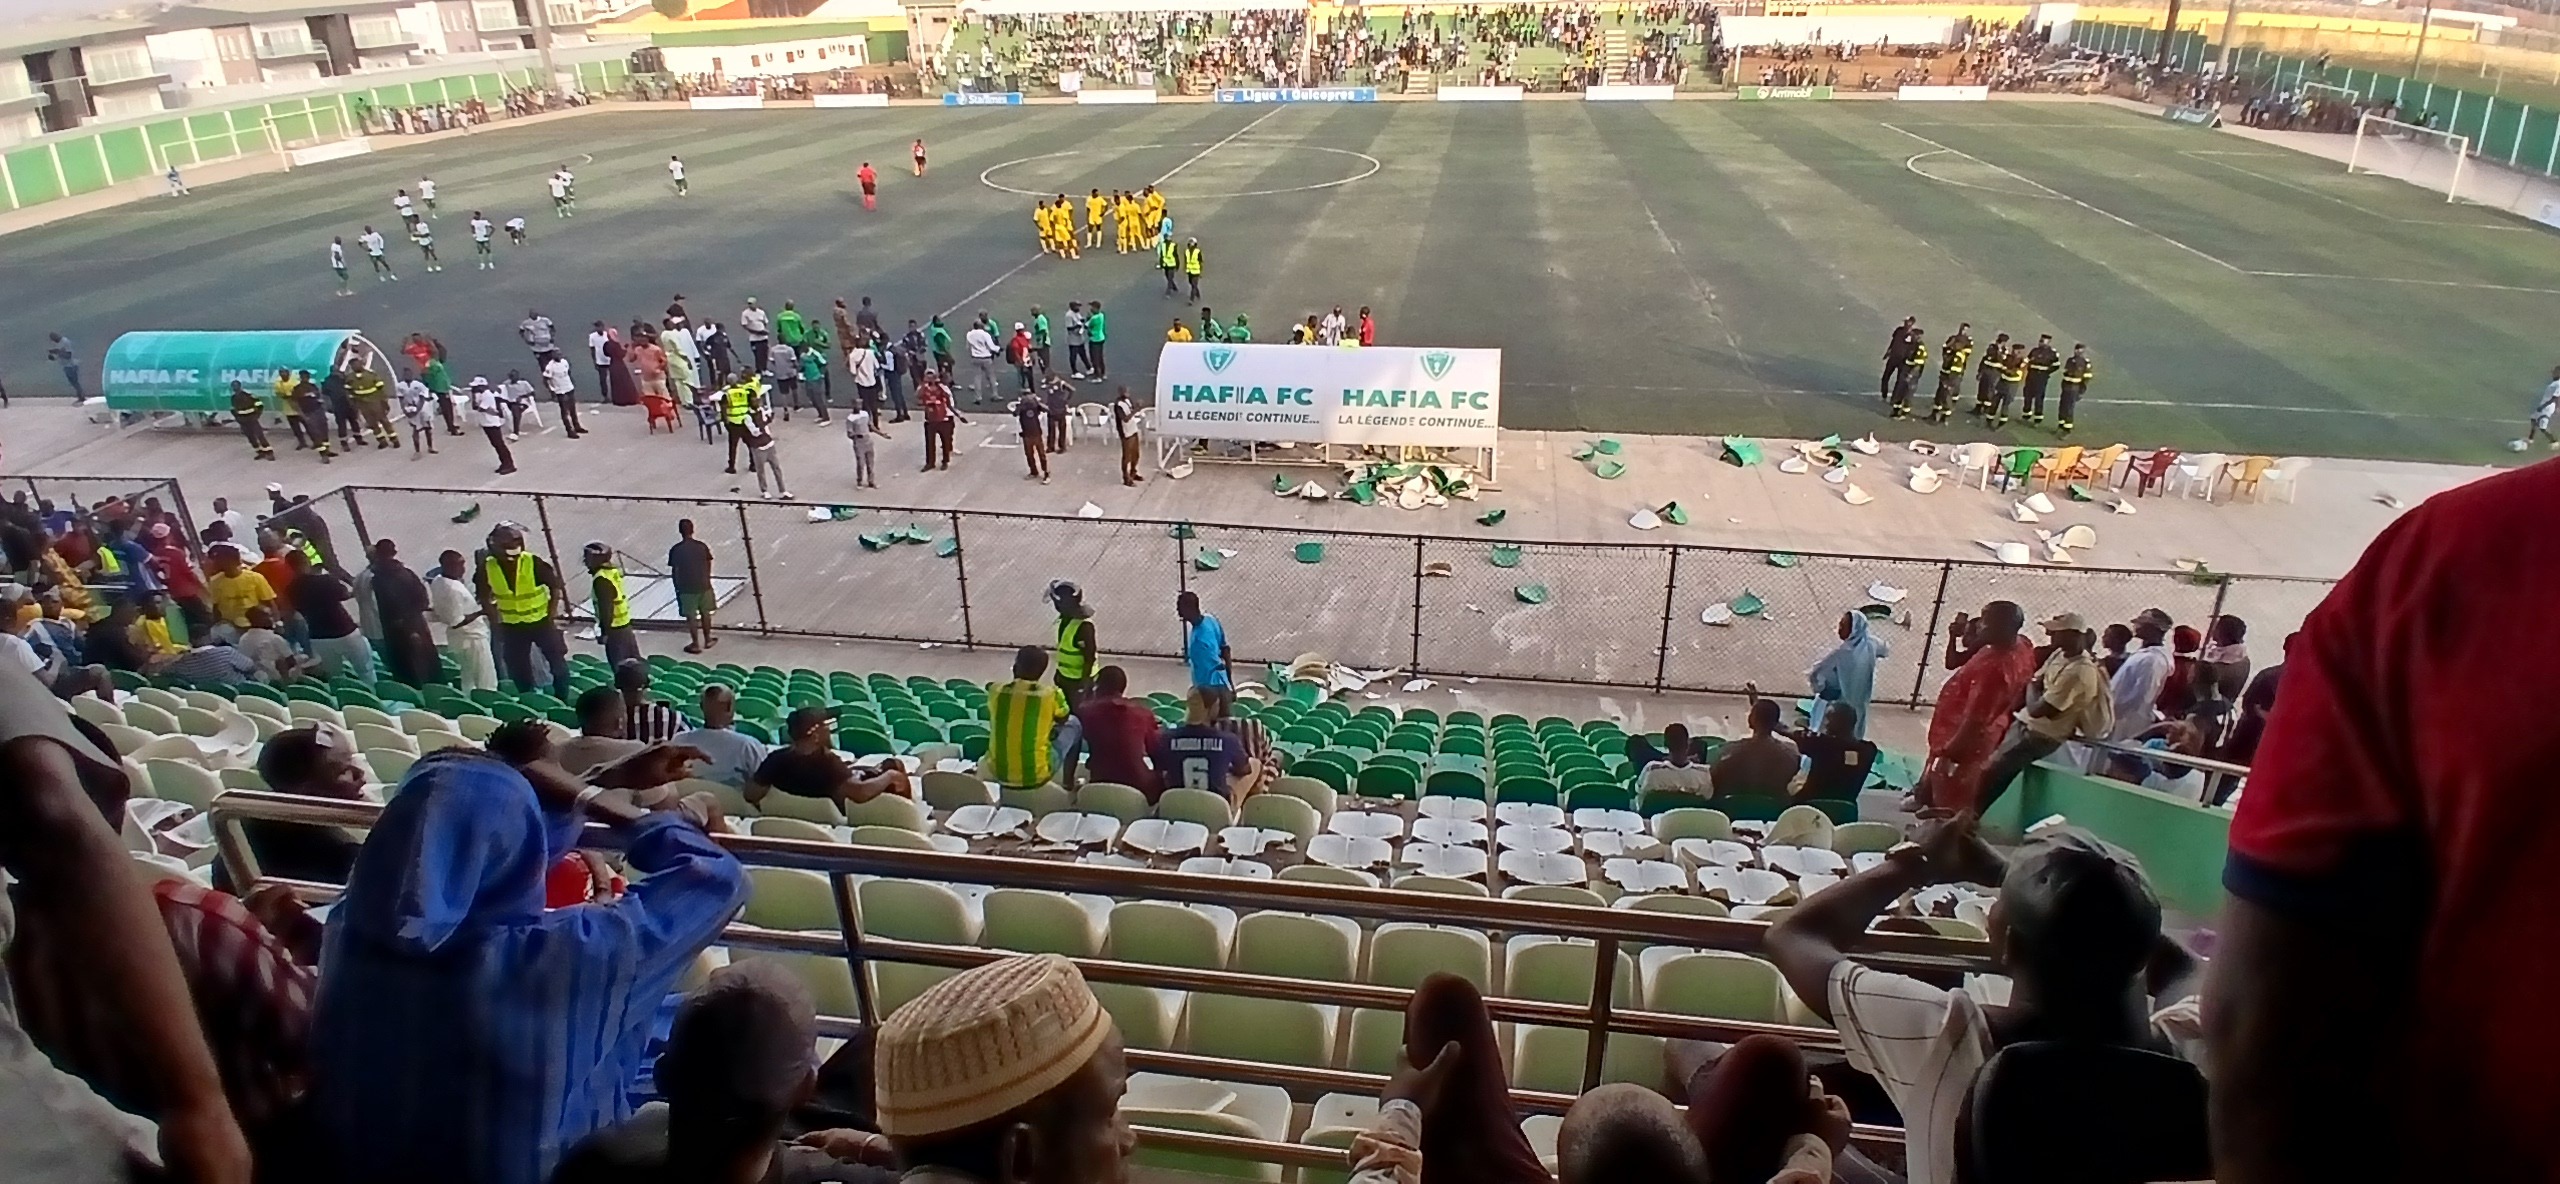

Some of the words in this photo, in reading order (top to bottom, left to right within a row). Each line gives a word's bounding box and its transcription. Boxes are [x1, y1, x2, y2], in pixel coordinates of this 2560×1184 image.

[1280, 89, 1287, 100] 1
[110, 369, 171, 384] HAFIA
[175, 369, 199, 383] FC
[1172, 385, 1268, 405] HAFIA
[1276, 387, 1314, 406] FC
[1342, 389, 1442, 409] HAFIA
[1450, 391, 1490, 410] FC
[1168, 410, 1184, 420] LA
[1246, 412, 1320, 424] CONTINUE...
[1338, 415, 1354, 425] LA
[1357, 414, 1416, 426] LÉGENDE
[1418, 416, 1496, 429] CONTINUE...
[1182, 757, 1209, 790] 6
